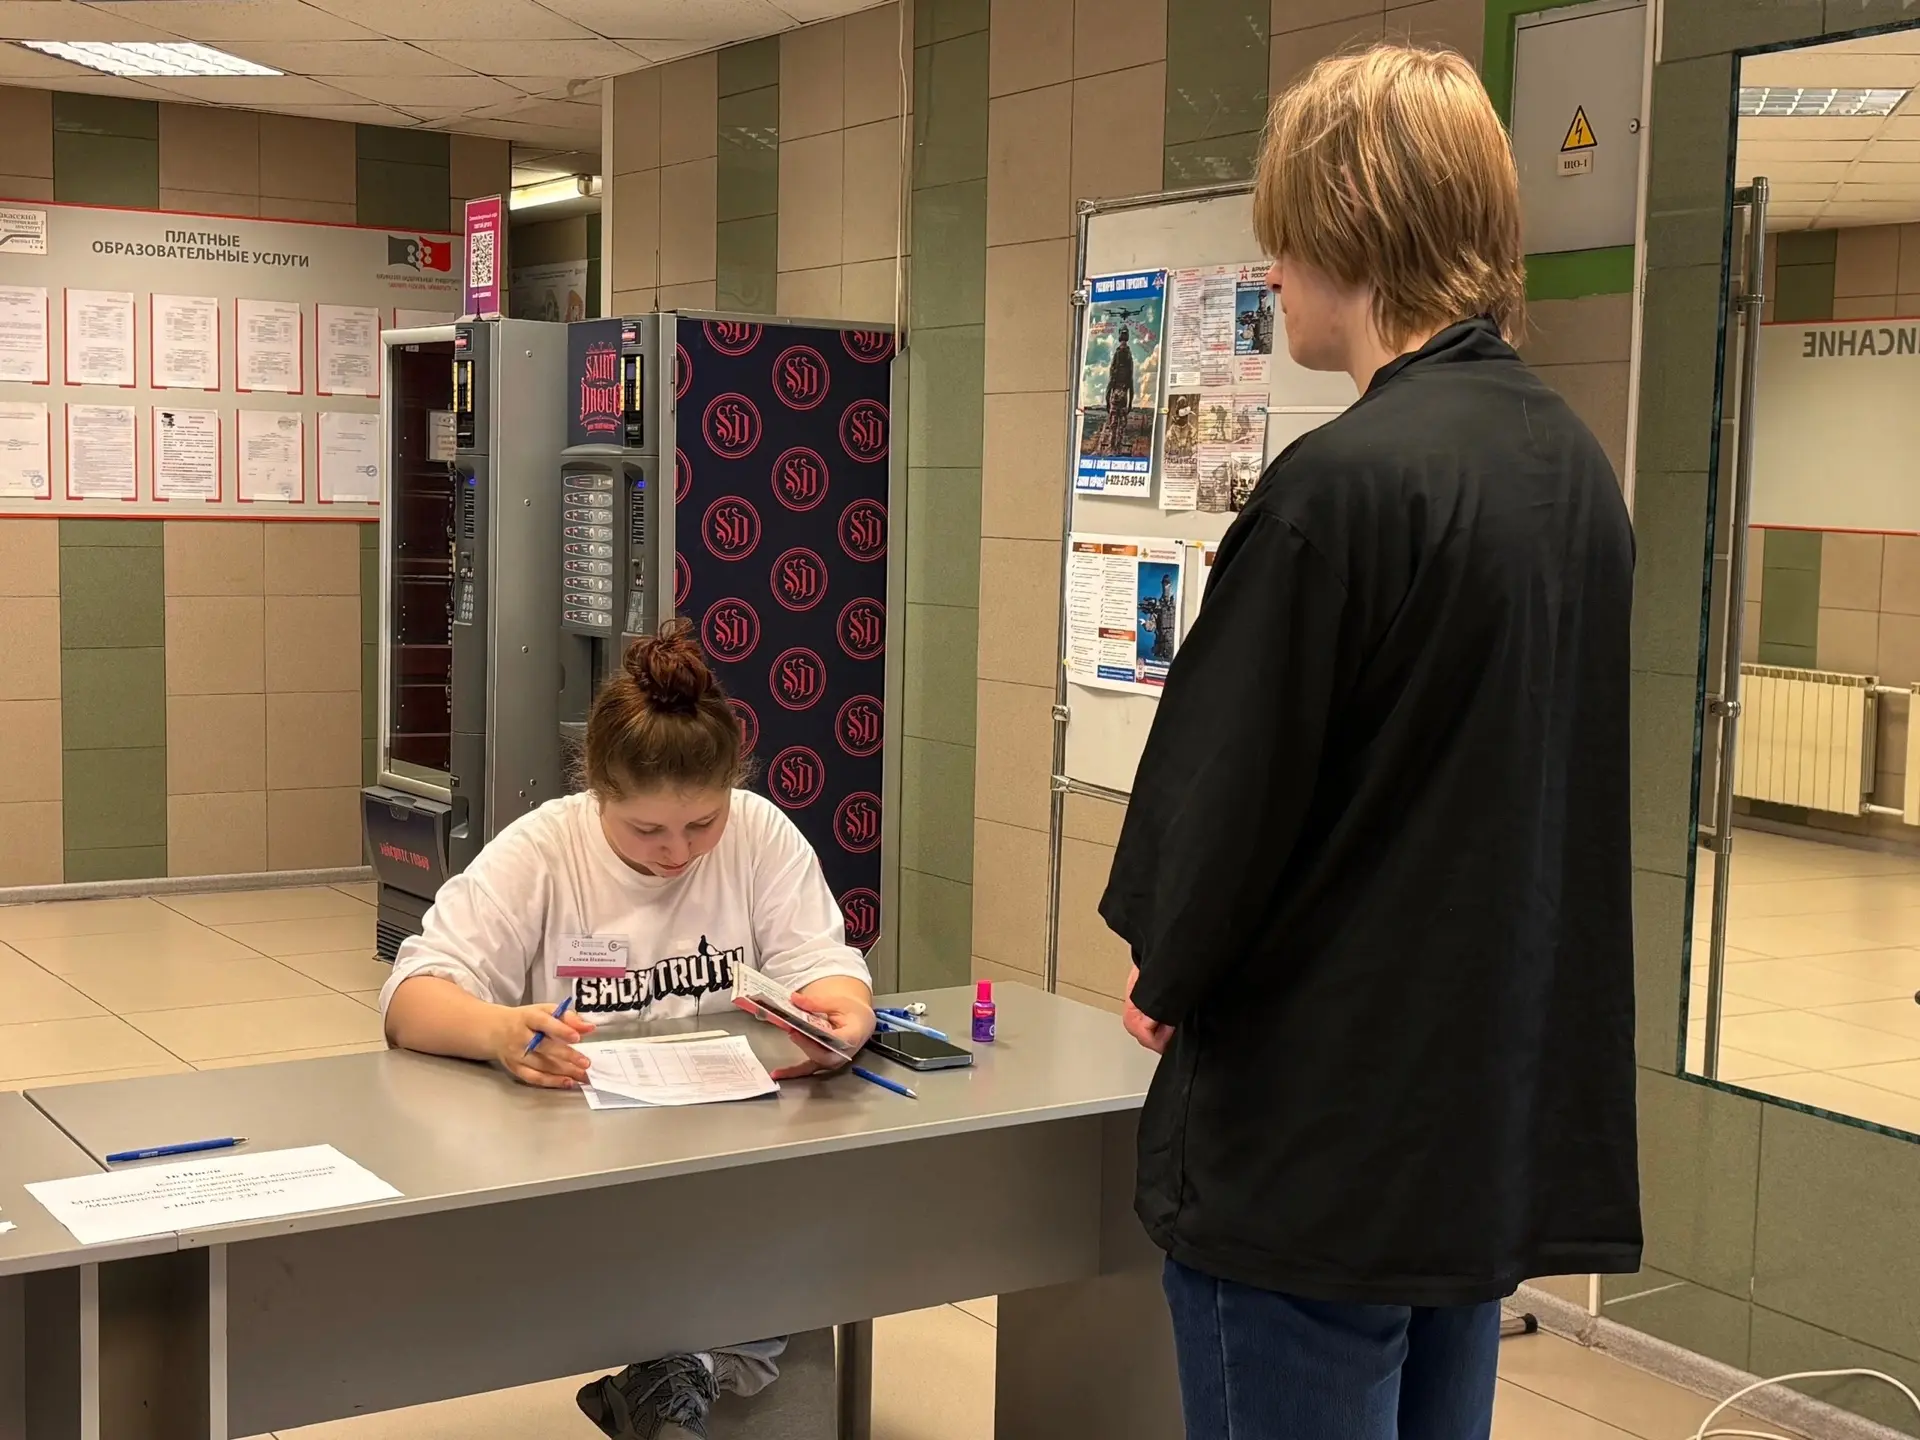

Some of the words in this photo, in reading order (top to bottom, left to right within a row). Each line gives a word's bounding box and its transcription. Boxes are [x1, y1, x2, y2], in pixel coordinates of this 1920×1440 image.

[0, 212, 36, 221] акасский
[165, 230, 240, 248] ПЛАТНЫЕ
[92, 240, 249, 264] ОБРАЗОВАТЕЛЬНЫЕ
[252, 252, 310, 268] УСЛУГИ
